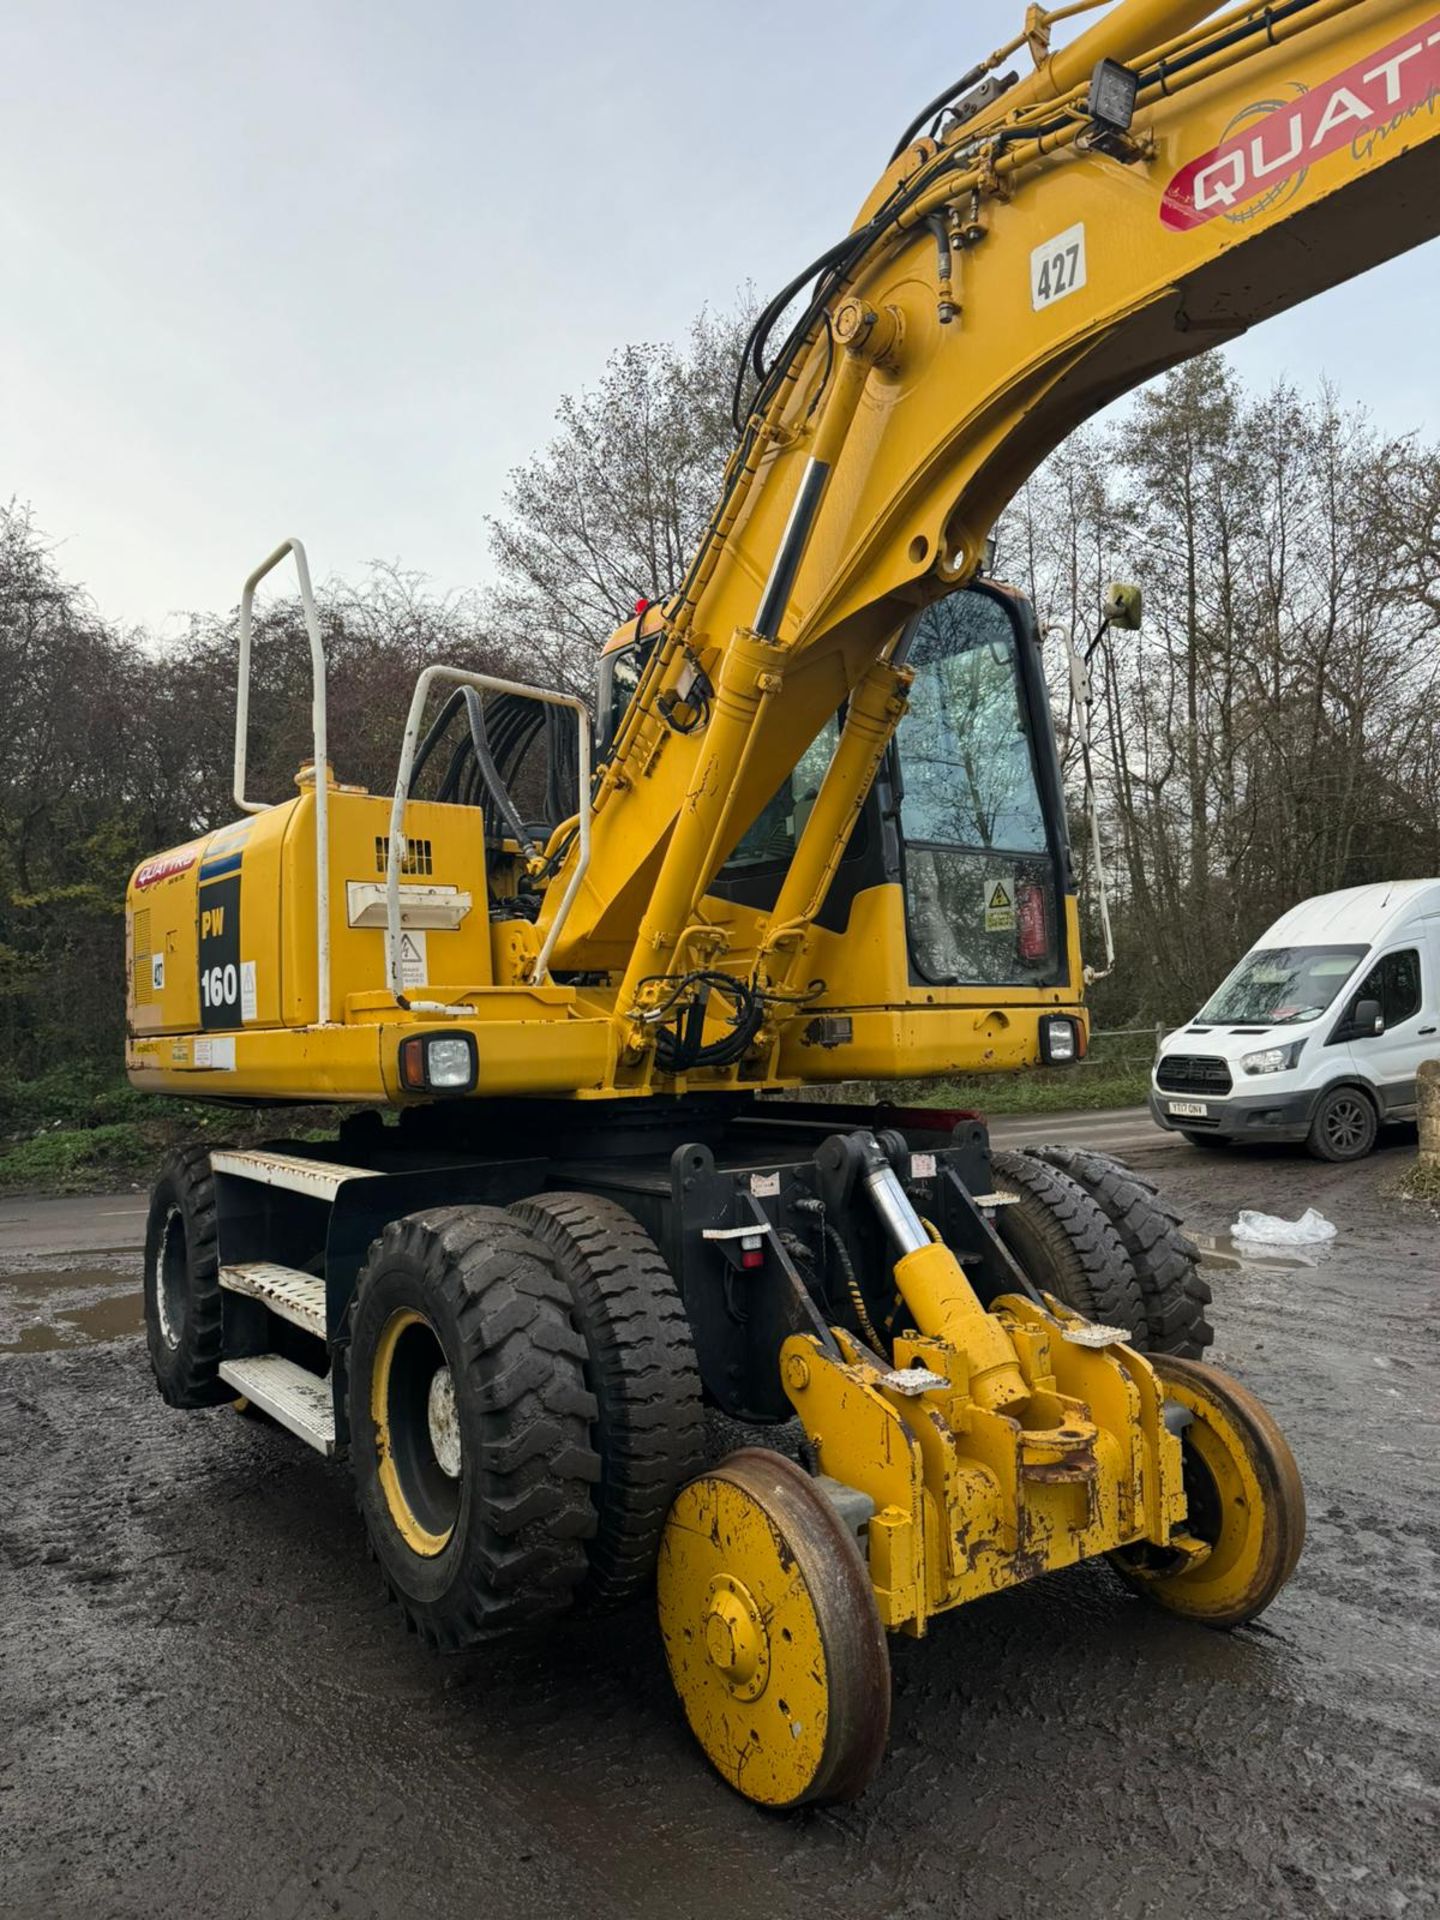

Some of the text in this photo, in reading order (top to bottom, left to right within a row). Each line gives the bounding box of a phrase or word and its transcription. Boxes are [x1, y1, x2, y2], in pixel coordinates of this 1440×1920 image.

[1038, 243, 1079, 300] 427
[202, 907, 224, 939] PW
[201, 964, 237, 1007] 160
